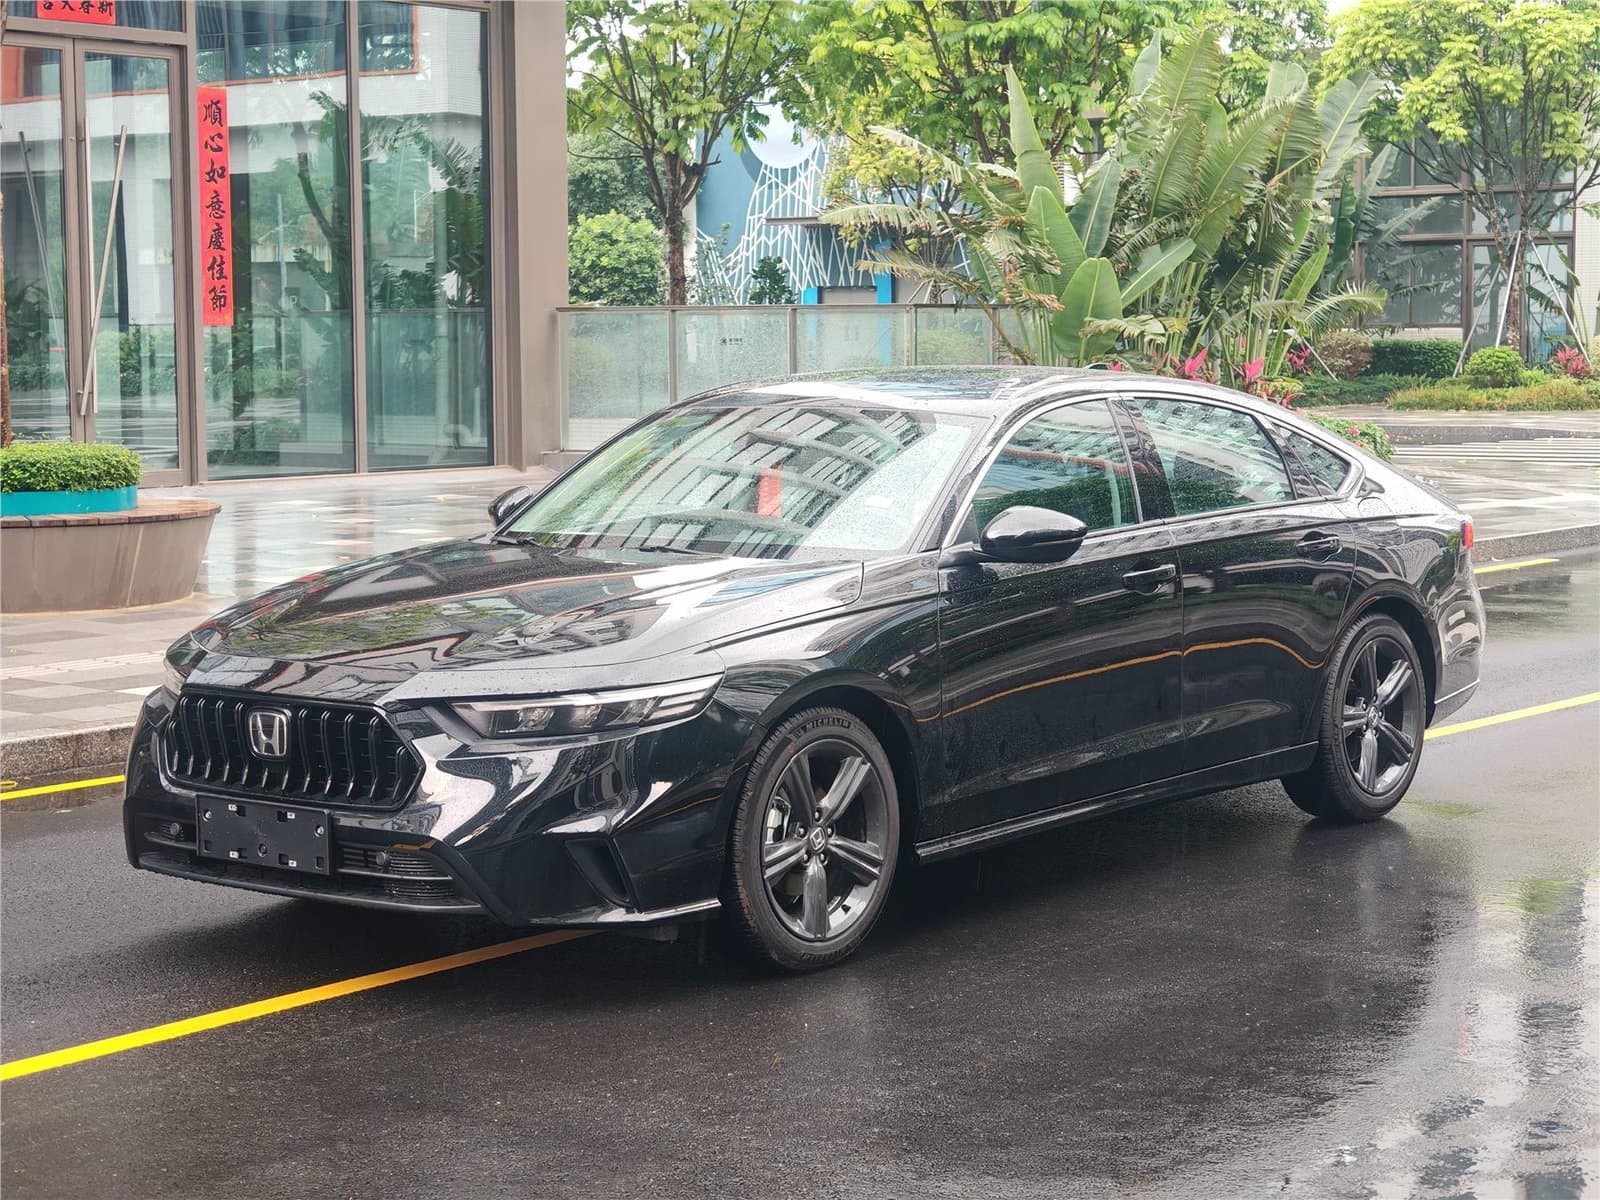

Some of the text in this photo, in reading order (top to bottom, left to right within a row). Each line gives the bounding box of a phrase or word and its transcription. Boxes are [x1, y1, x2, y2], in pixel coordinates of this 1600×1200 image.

[203, 100, 228, 312] 順心如意慶佳節
